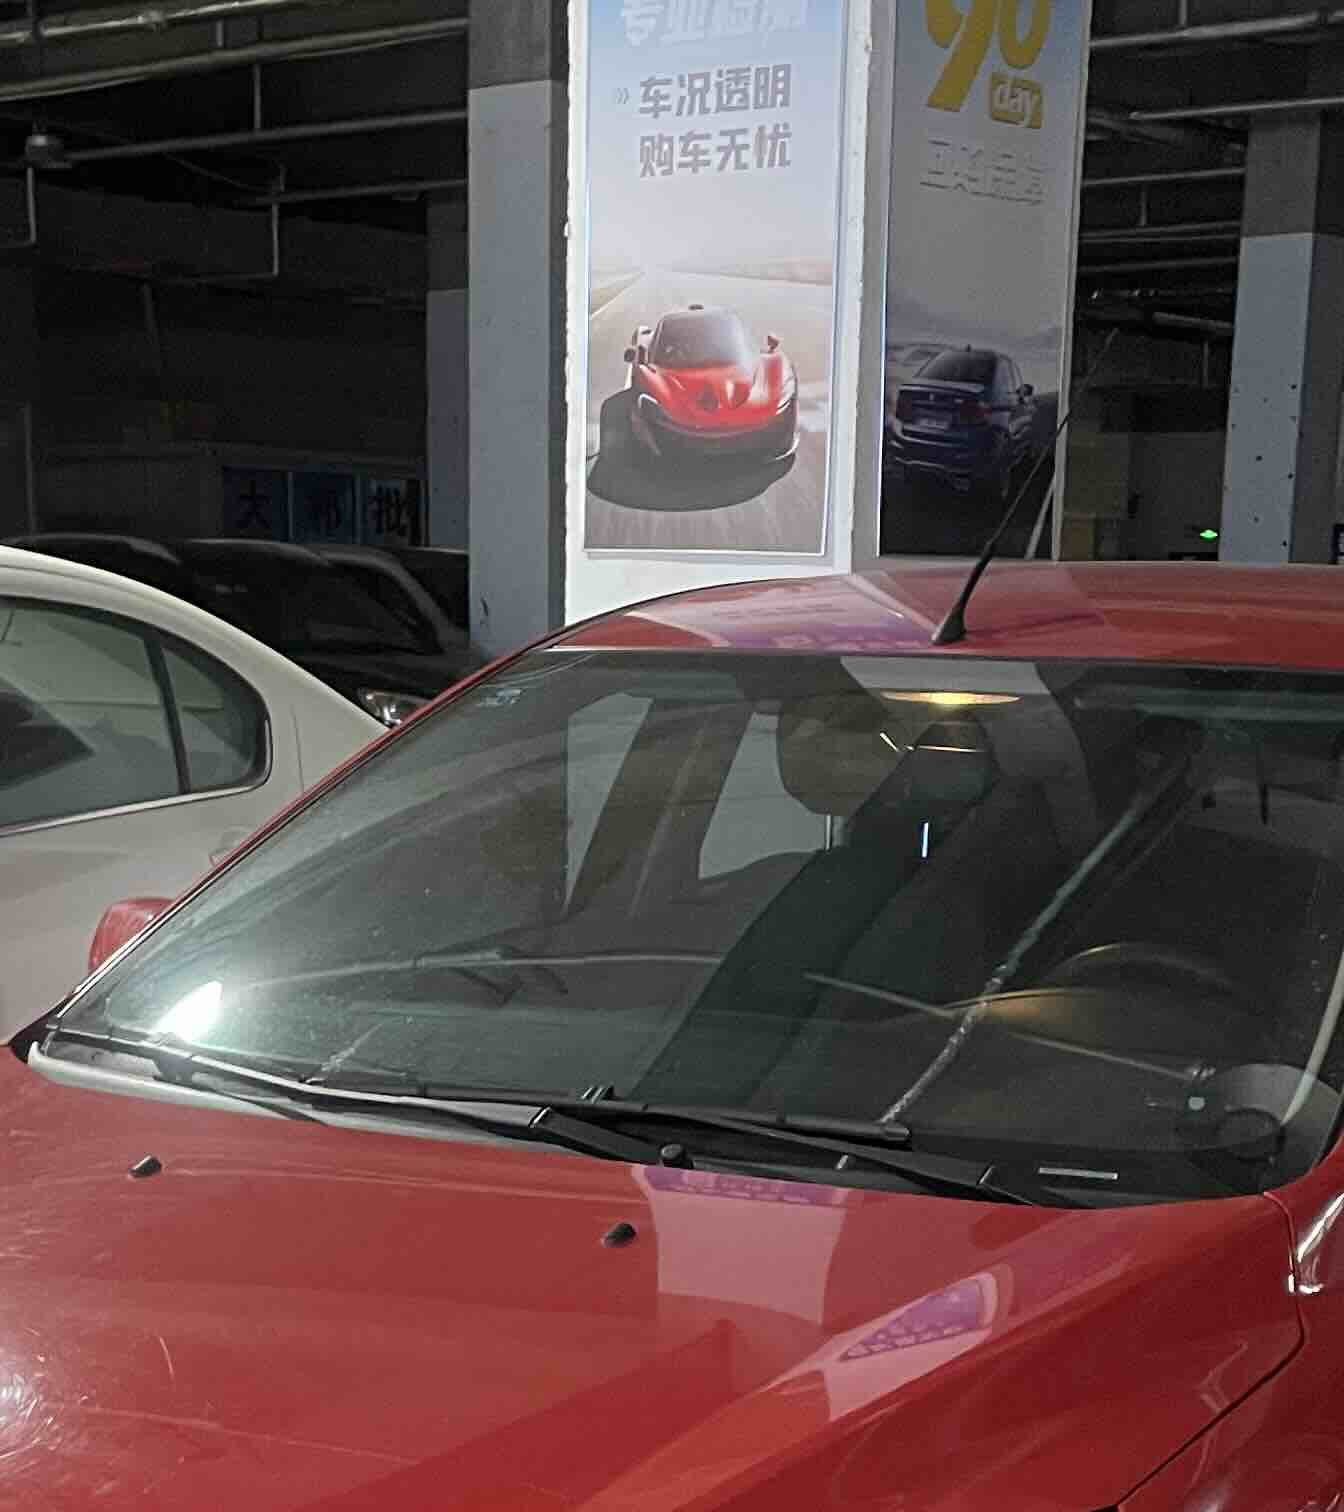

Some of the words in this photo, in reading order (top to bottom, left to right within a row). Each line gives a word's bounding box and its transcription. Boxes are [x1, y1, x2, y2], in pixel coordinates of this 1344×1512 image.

[639, 64, 791, 118] 车况透明
[992, 79, 1040, 127] day
[639, 123, 792, 178] 购车无忧
